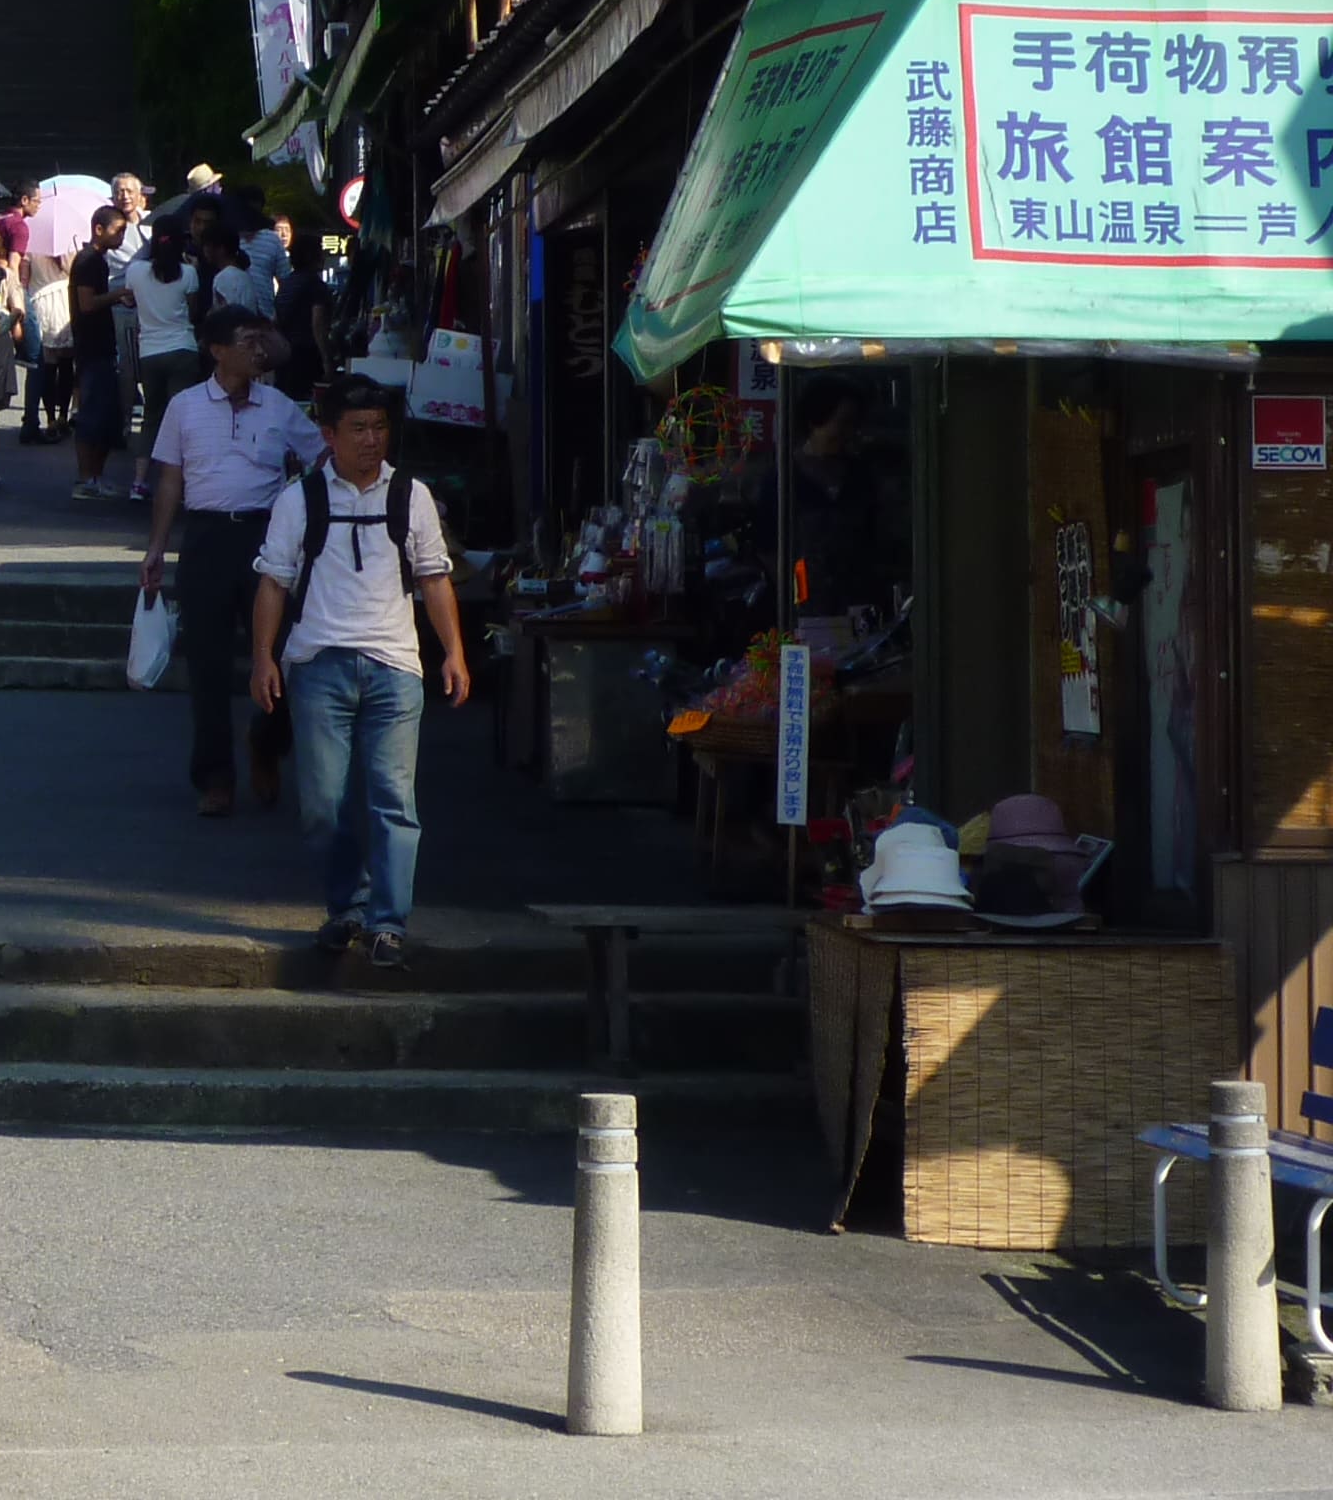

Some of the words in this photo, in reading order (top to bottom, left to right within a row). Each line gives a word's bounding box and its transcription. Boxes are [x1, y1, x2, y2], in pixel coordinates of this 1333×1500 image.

[1012, 30, 1333, 97] 手荷物預
[905, 60, 958, 246] 武藤商店
[1257, 446, 1321, 463] SECOM
